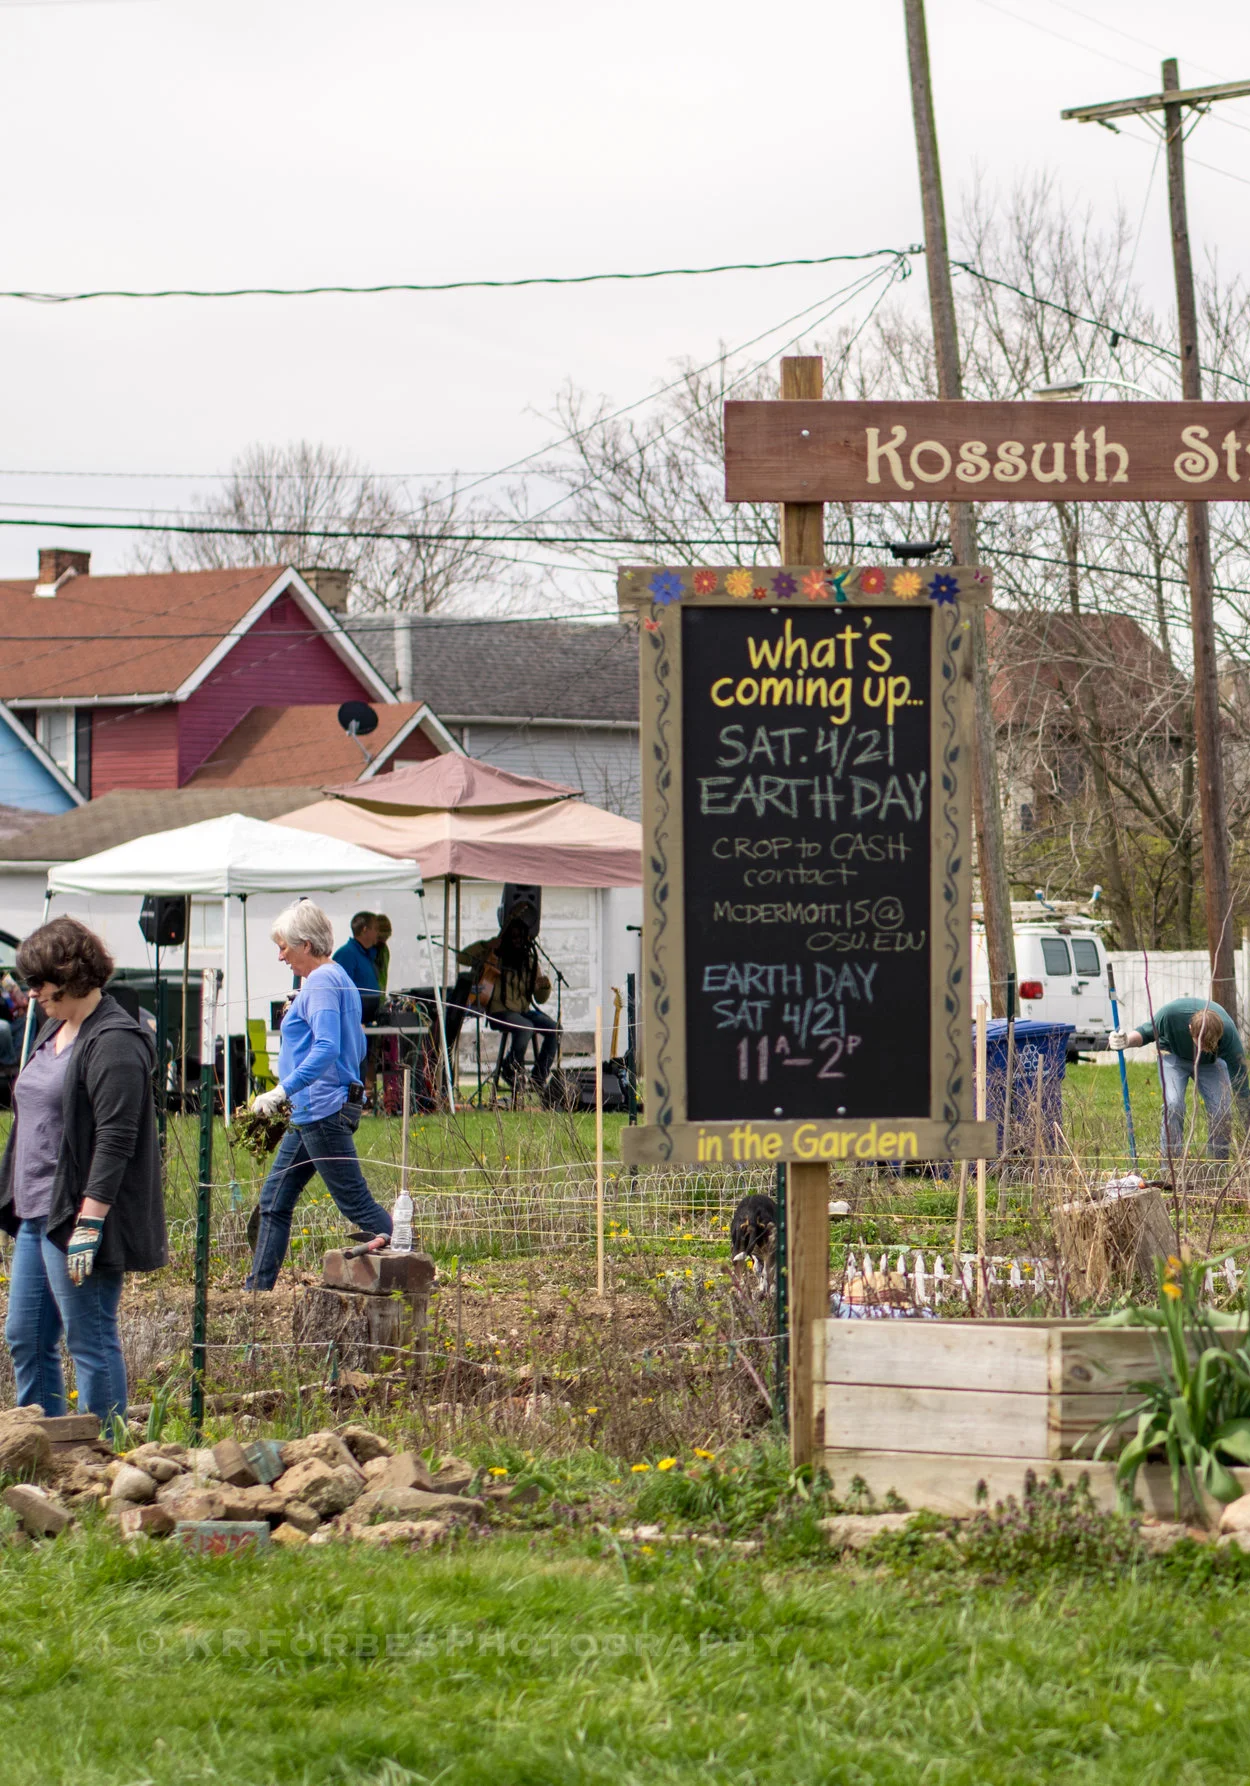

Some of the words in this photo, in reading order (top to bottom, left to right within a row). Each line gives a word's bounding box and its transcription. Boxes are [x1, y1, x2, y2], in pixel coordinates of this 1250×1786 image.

[865, 425, 1129, 491] Kossuth
[711, 669, 852, 725] coming
[715, 724, 808, 768] SAT.
[815, 726, 895, 779] 4/21
[697, 775, 845, 821] EARTH
[850, 771, 927, 822] DAY
[712, 837, 793, 859] CROP
[831, 832, 912, 862] CASH
[743, 863, 858, 887] contact
[807, 930, 926, 952] OSU.EDU
[702, 962, 801, 995] EARTH
[815, 961, 878, 1002] DAY
[712, 999, 771, 1030] SAT
[782, 998, 846, 1049] 4/21
[697, 1128, 723, 1162] in
[728, 1123, 783, 1160] the
[793, 1122, 919, 1160] Garden
